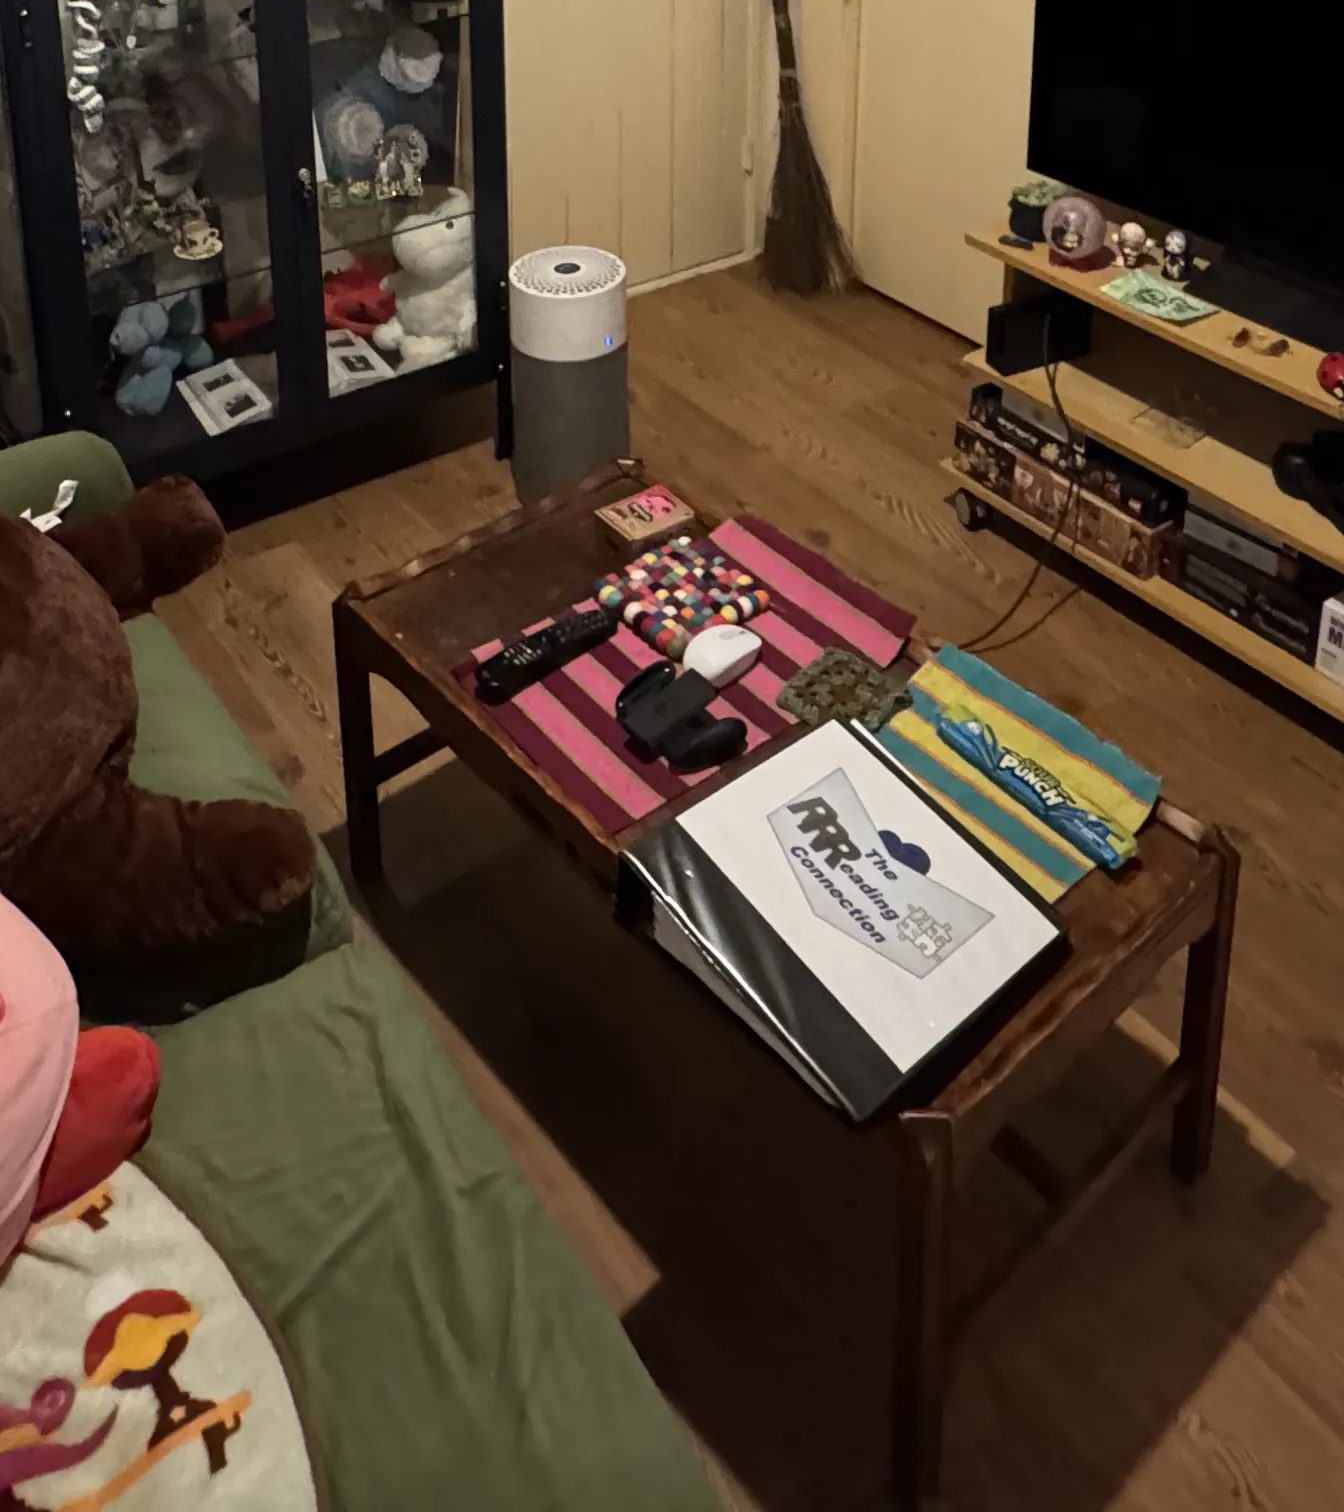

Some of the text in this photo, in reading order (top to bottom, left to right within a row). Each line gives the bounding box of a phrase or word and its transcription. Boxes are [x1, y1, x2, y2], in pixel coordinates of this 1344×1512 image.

[999, 754, 1065, 807] PUNCH
[864, 848, 898, 882] The
[790, 845, 887, 944] Connection
